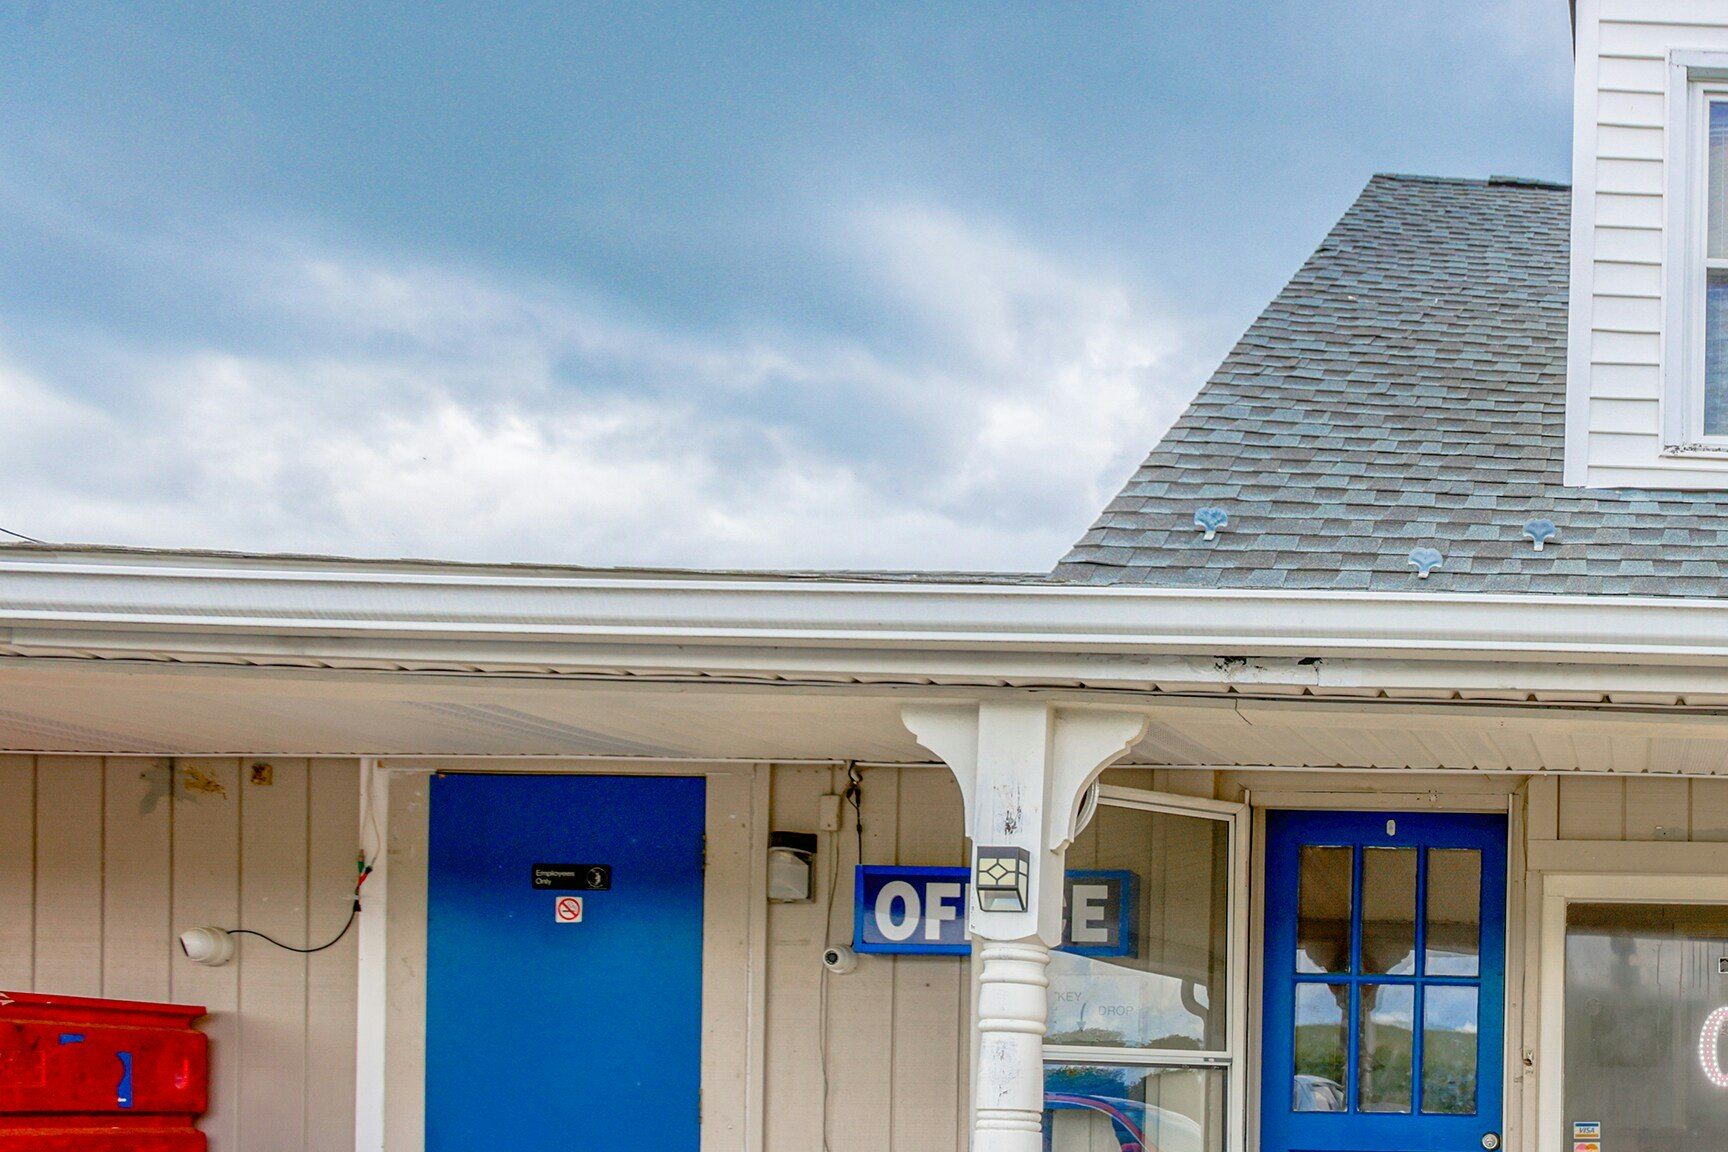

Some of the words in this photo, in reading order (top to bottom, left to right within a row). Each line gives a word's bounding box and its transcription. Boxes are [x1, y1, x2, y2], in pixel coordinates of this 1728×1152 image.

[535, 869, 575, 878] Employees
[535, 878, 552, 886] Only
[875, 880, 1109, 943] OFE
[1098, 1005, 1134, 1016] DROP
